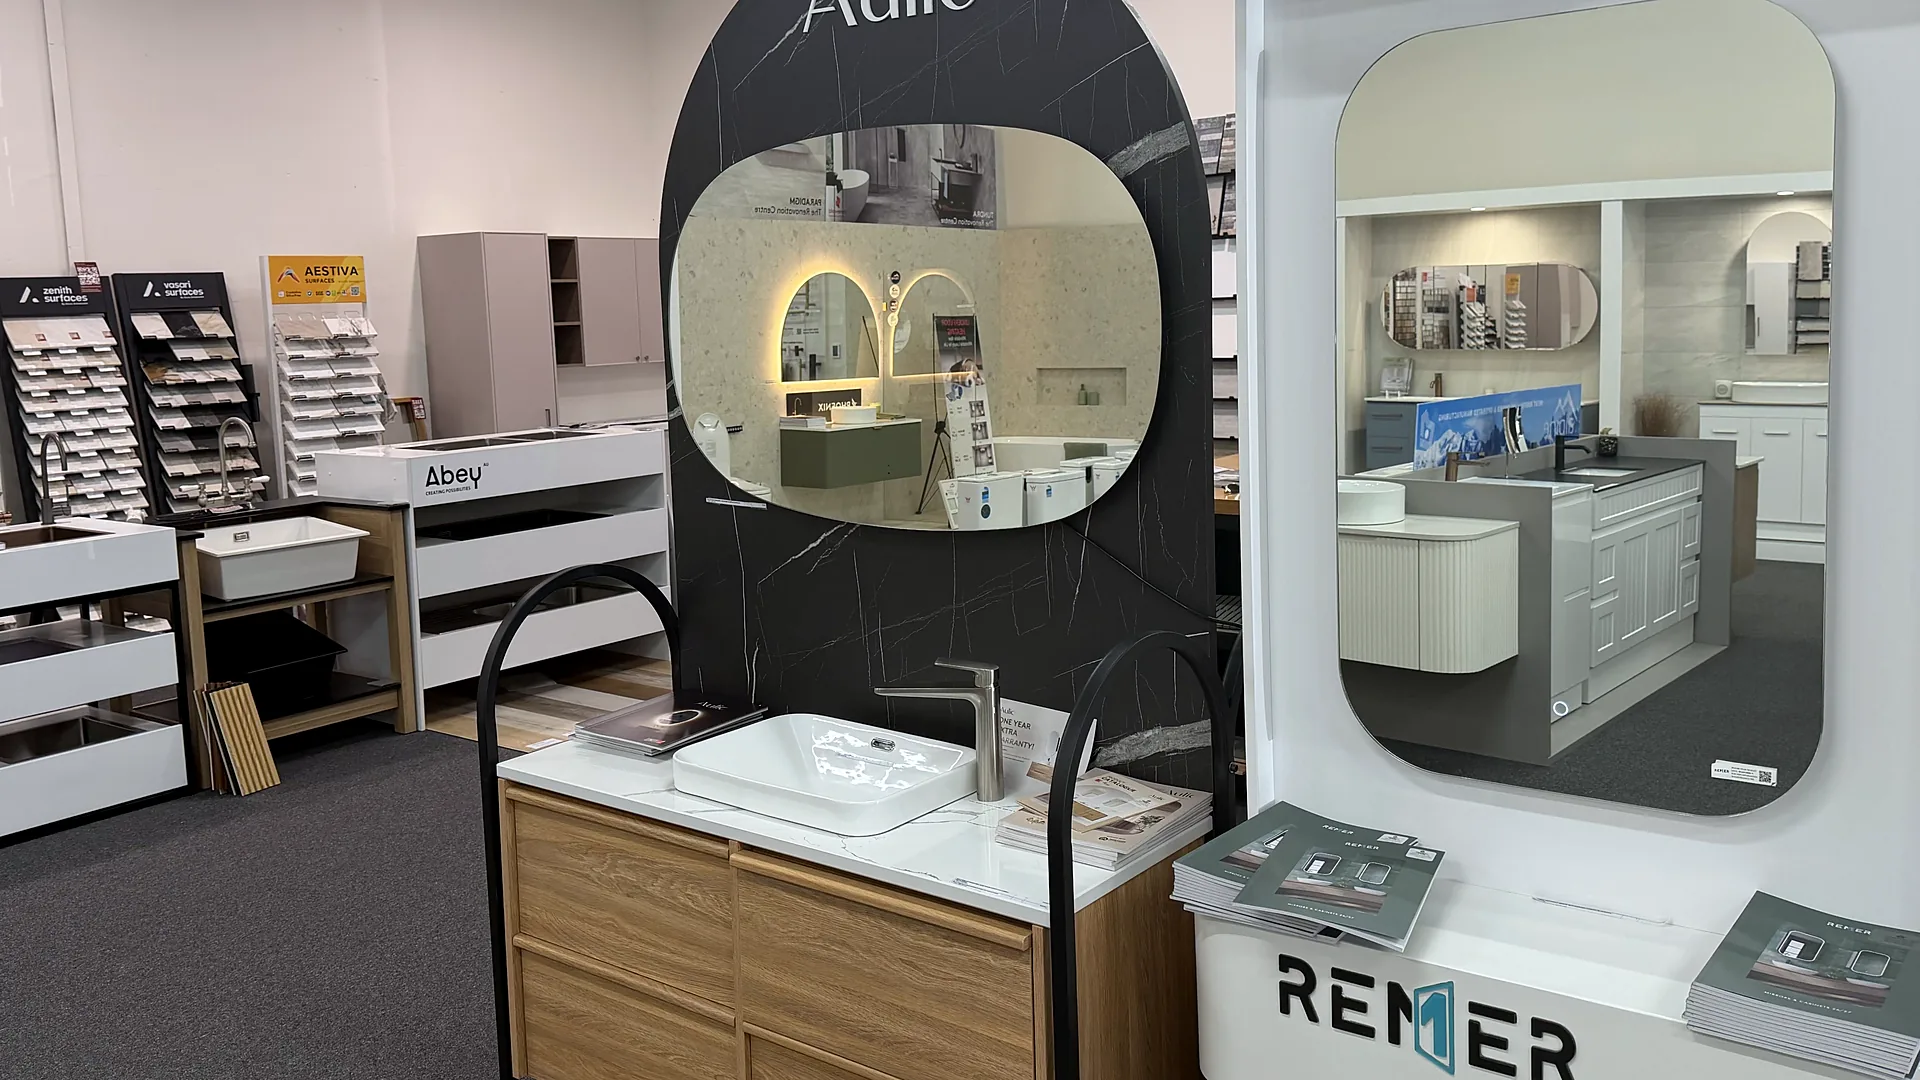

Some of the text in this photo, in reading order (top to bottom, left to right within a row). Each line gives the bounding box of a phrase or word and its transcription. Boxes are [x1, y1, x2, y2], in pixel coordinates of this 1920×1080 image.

[304, 266, 359, 276] AESTIVA
[163, 280, 191, 289] vasari
[43, 286, 73, 295] zenith
[165, 288, 204, 297] surfaces
[44, 294, 89, 303] surfaces
[425, 465, 482, 489] Abey
[425, 486, 471, 496] CREATING POSSIBILITIES
[1013, 718, 1032, 730] YEAR
[1001, 726, 1018, 737] XTRA
[1002, 736, 1035, 750] ARRANTY!
